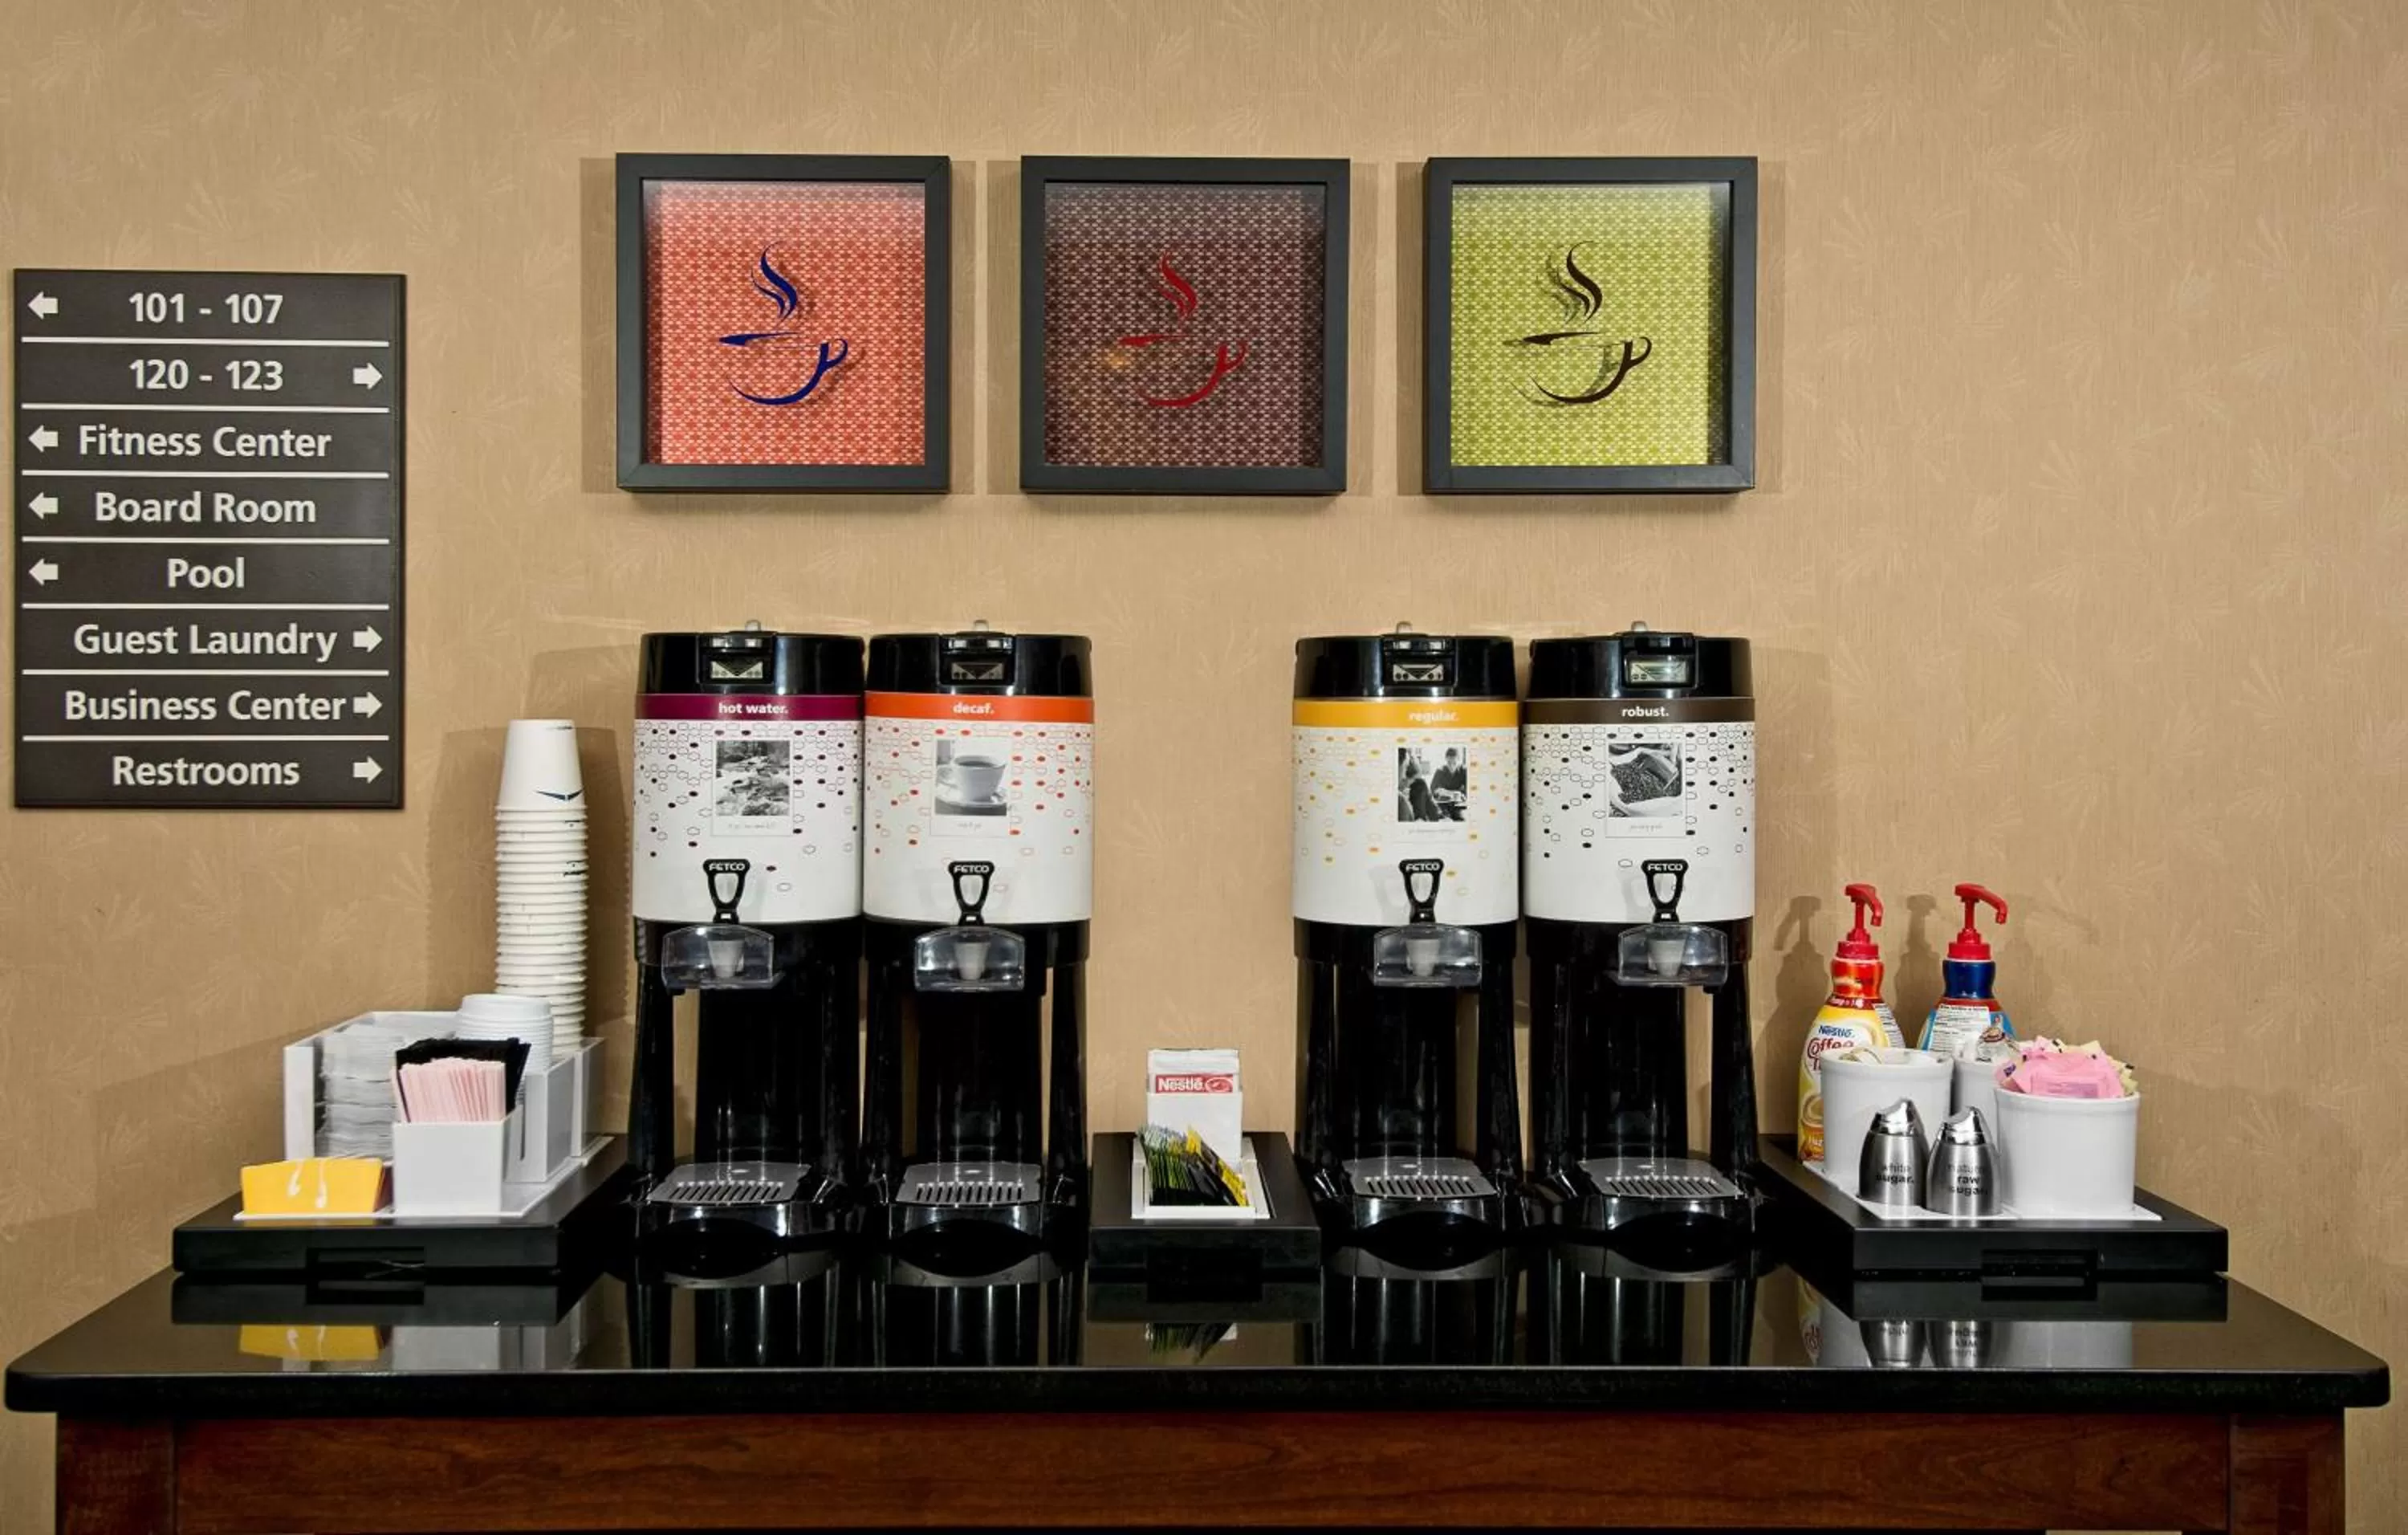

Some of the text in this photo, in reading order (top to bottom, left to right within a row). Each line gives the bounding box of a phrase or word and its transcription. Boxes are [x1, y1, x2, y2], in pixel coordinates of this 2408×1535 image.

[129, 293, 183, 323] 101
[226, 294, 283, 324] 107
[129, 360, 188, 389] 120
[226, 360, 283, 390] 123
[79, 424, 332, 457] Fitness Center
[96, 491, 315, 522] Board Room
[168, 557, 244, 588] Pool
[74, 623, 337, 662] Guest Laundry
[66, 690, 346, 720] Business Center
[718, 702, 742, 714] hot
[1621, 706, 1670, 717] robust.
[114, 756, 299, 786] Restrooms
[709, 863, 745, 871] FETCO
[953, 865, 989, 873] FETCO
[1405, 862, 1440, 871] FETCO
